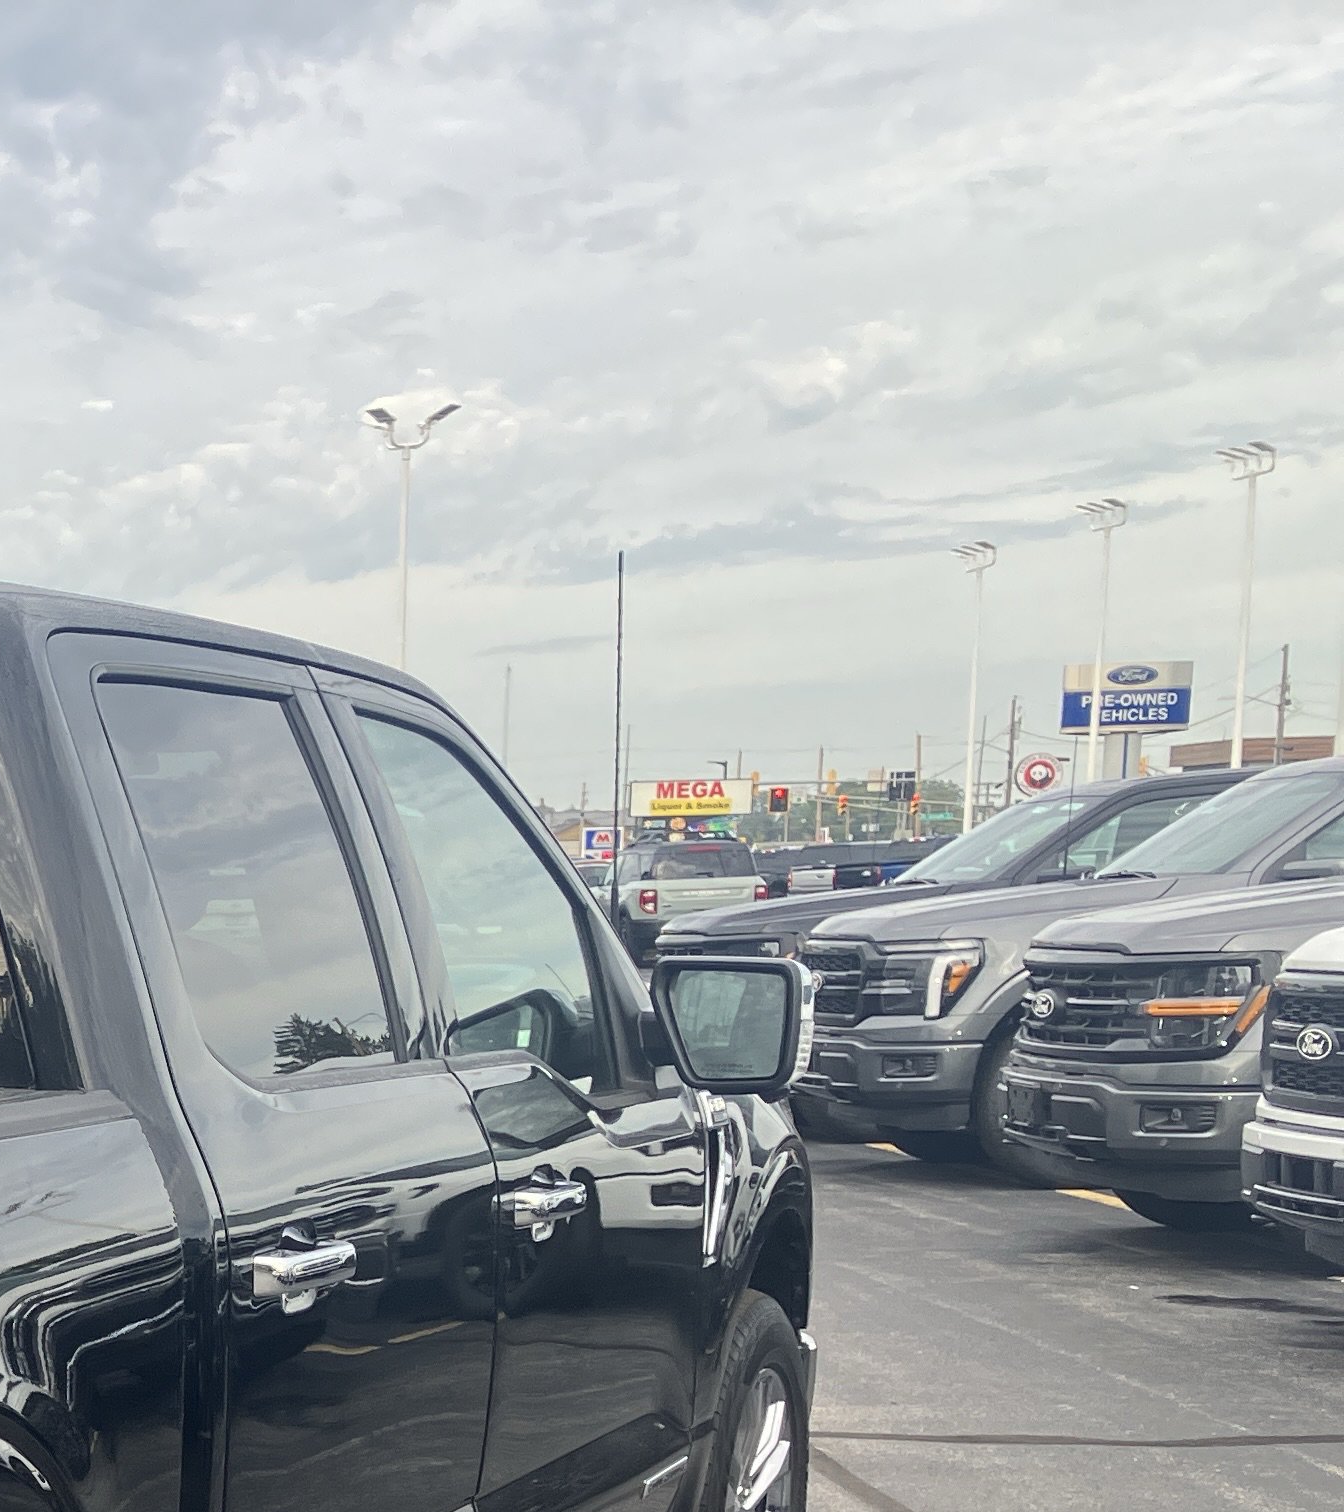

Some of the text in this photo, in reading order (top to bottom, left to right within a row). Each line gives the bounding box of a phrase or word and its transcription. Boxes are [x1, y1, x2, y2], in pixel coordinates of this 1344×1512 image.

[1080, 692, 1179, 708] PE-OWNED
[1100, 707, 1170, 722] EHICLES
[655, 780, 725, 799] MEGA
[696, 802, 730, 811] Smoke
